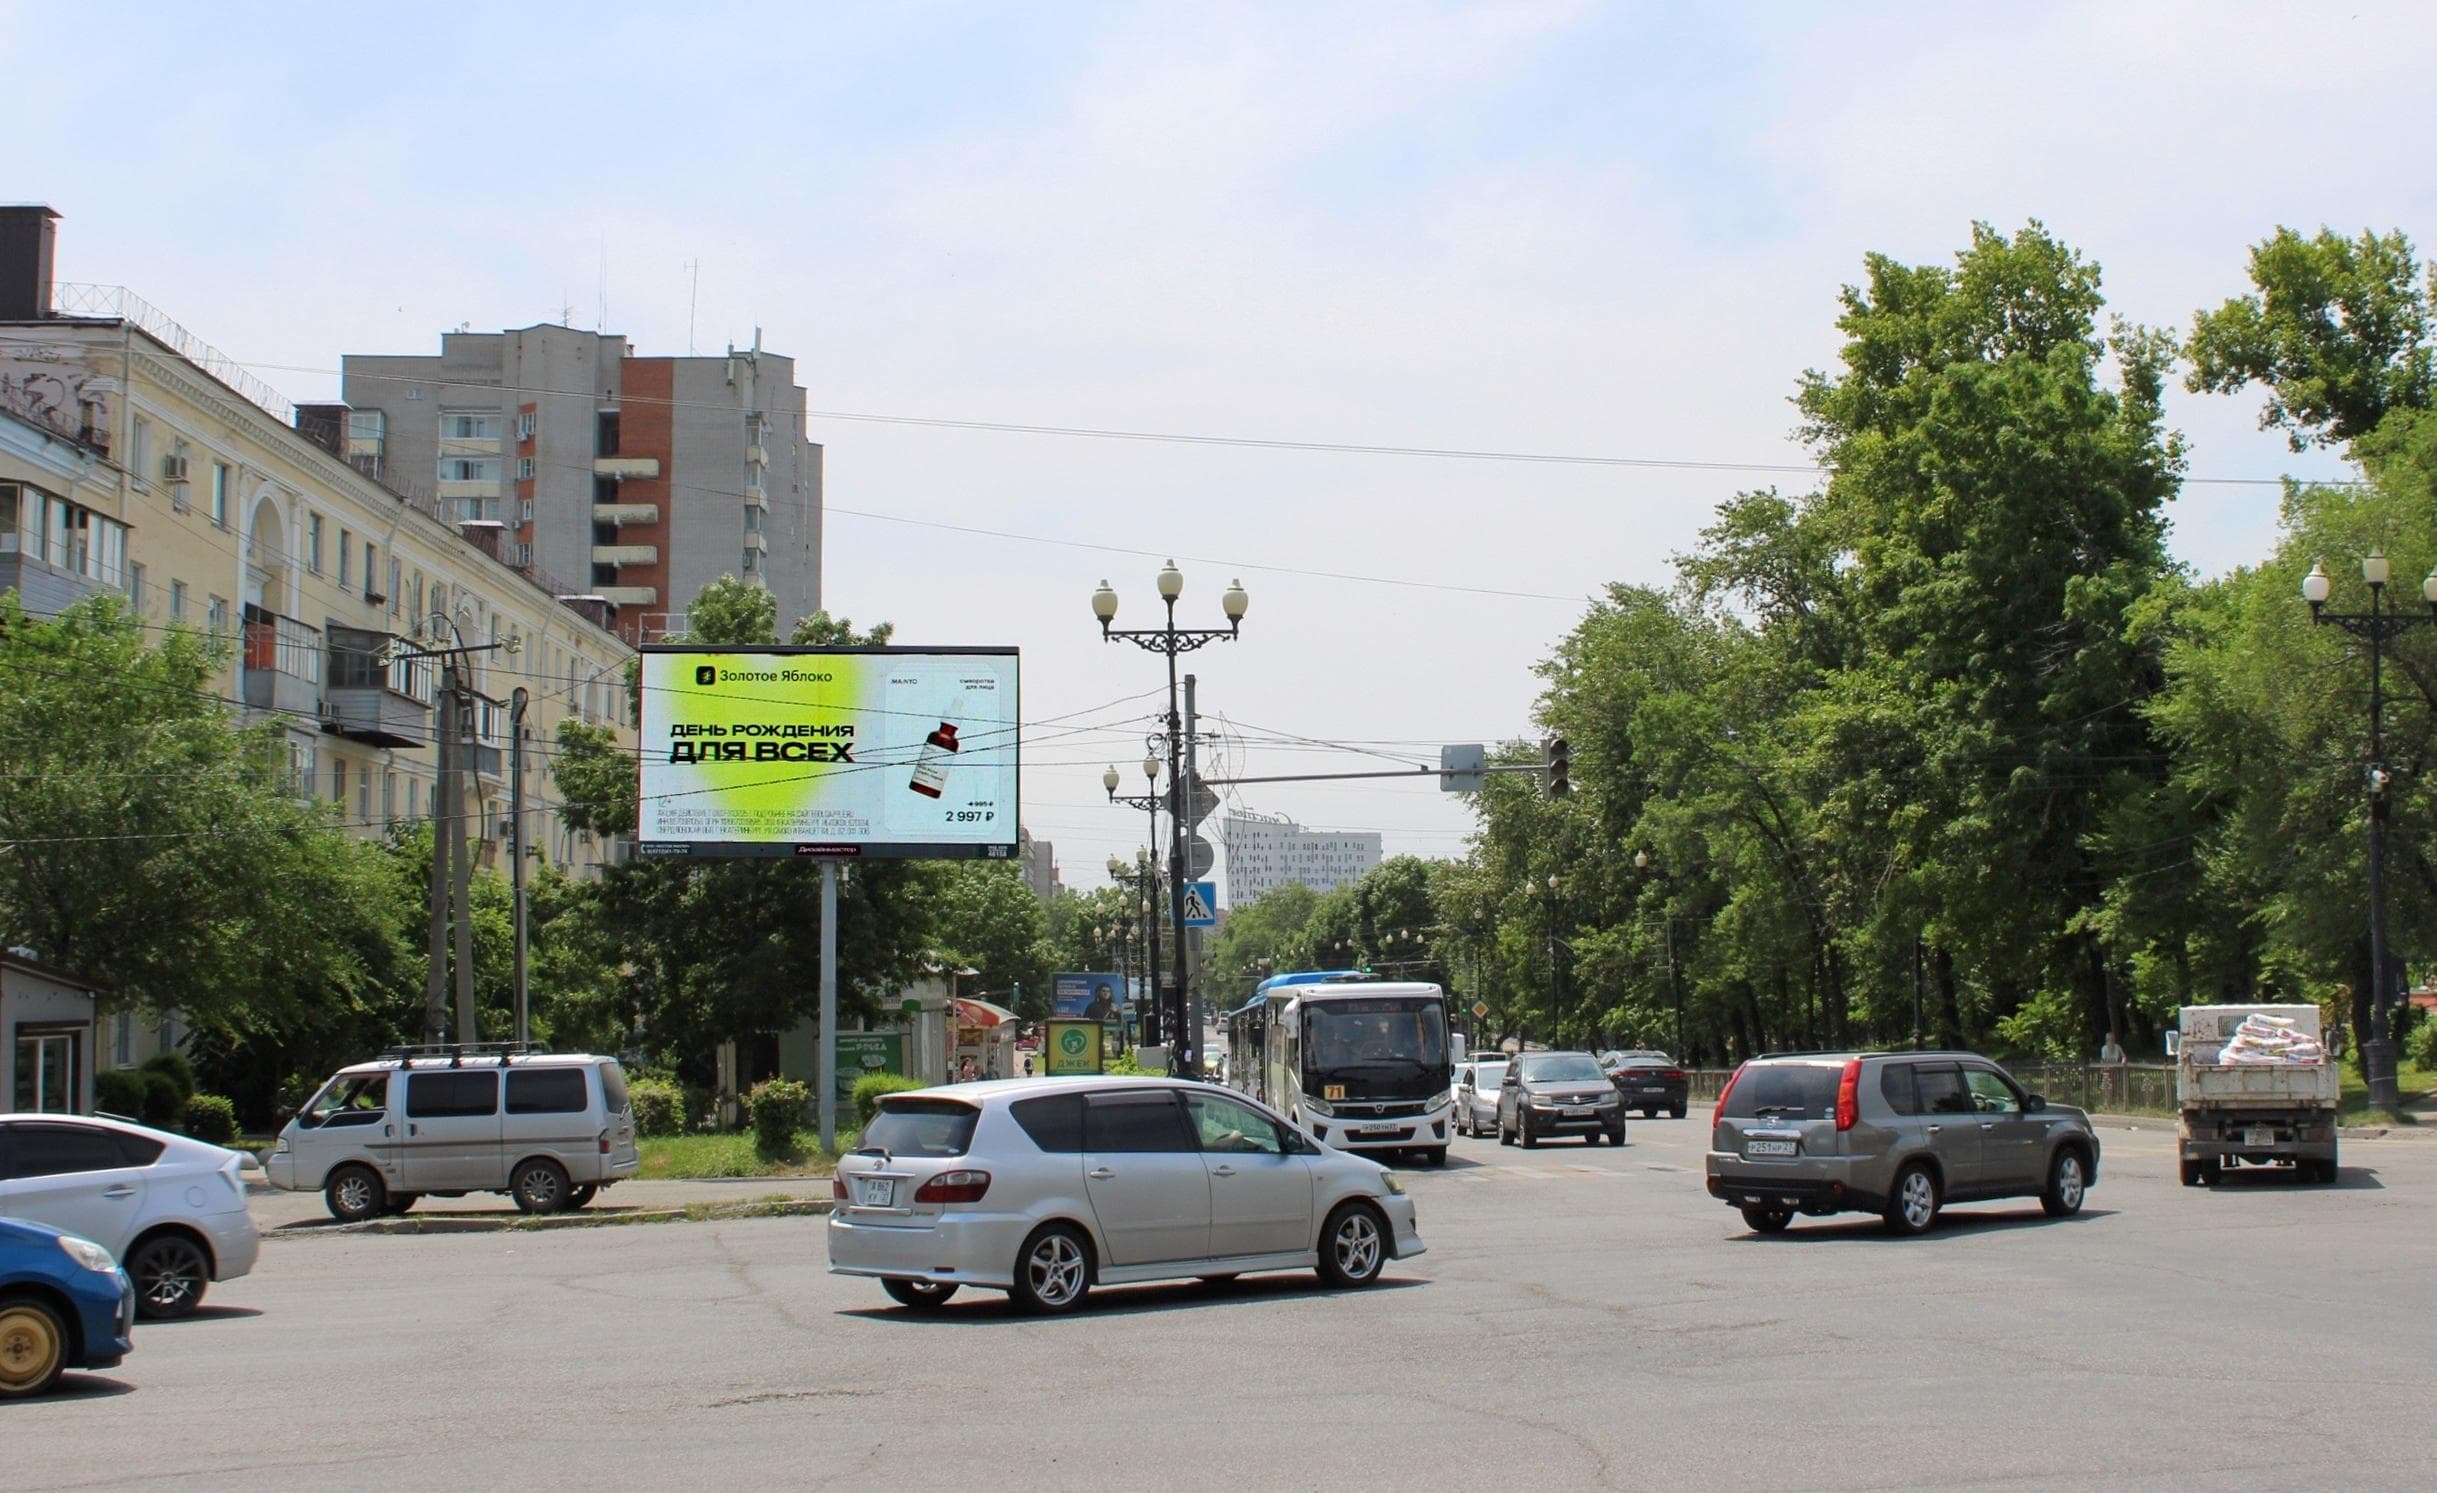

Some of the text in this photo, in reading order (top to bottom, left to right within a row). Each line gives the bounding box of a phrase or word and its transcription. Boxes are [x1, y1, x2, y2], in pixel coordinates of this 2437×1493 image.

[719, 669, 833, 682] Золотое Яблоко
[670, 724, 855, 739] ДЕНЬ РОЖДЕНИЯ
[669, 741, 855, 764] ДЛЯ ВСЕХ
[945, 810, 954, 822] 2
[957, 810, 982, 822] 997
[1327, 1086, 1342, 1098] 71
